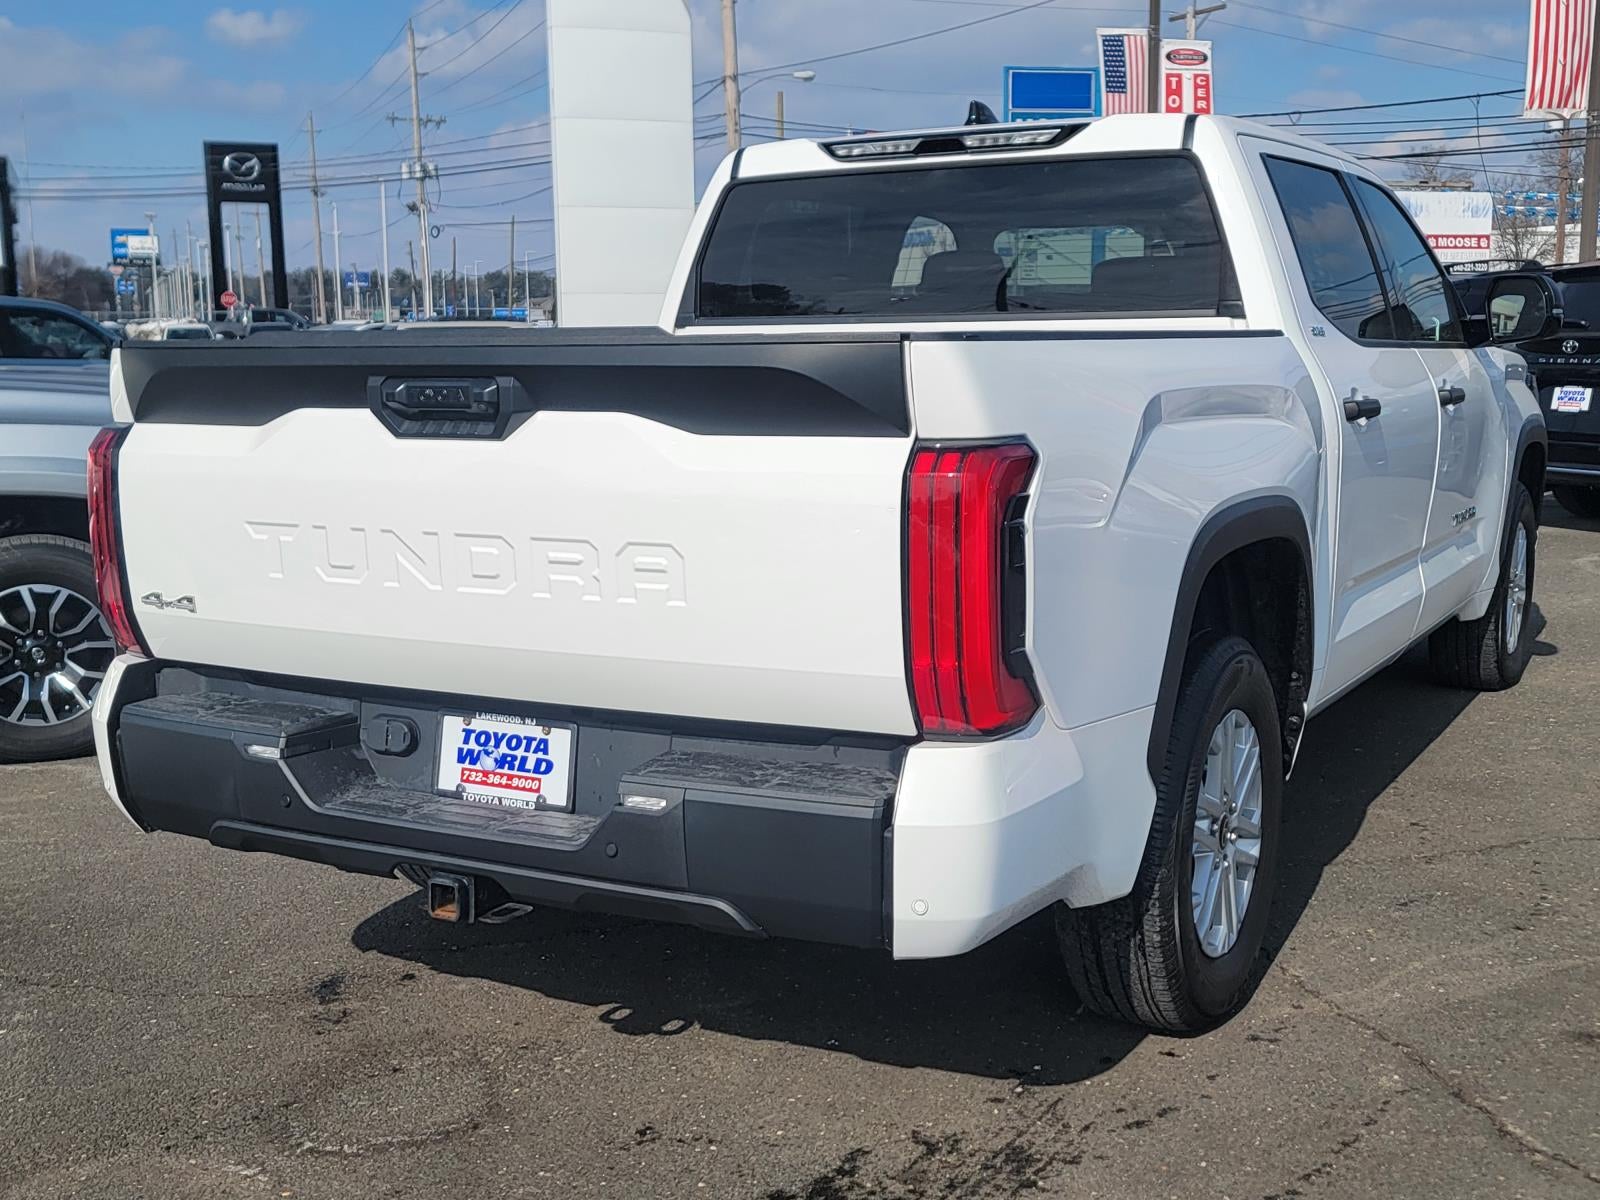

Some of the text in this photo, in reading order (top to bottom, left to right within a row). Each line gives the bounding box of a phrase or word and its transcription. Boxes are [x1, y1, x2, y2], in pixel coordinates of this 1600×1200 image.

[1437, 237, 1478, 248] MOOSE
[243, 521, 687, 606] TUNDRA
[525, 717, 537, 726] NJ
[461, 727, 550, 756] TOYOTA
[462, 770, 540, 790] 732-364-9000
[462, 792, 536, 810] TOYOTA WORLD
